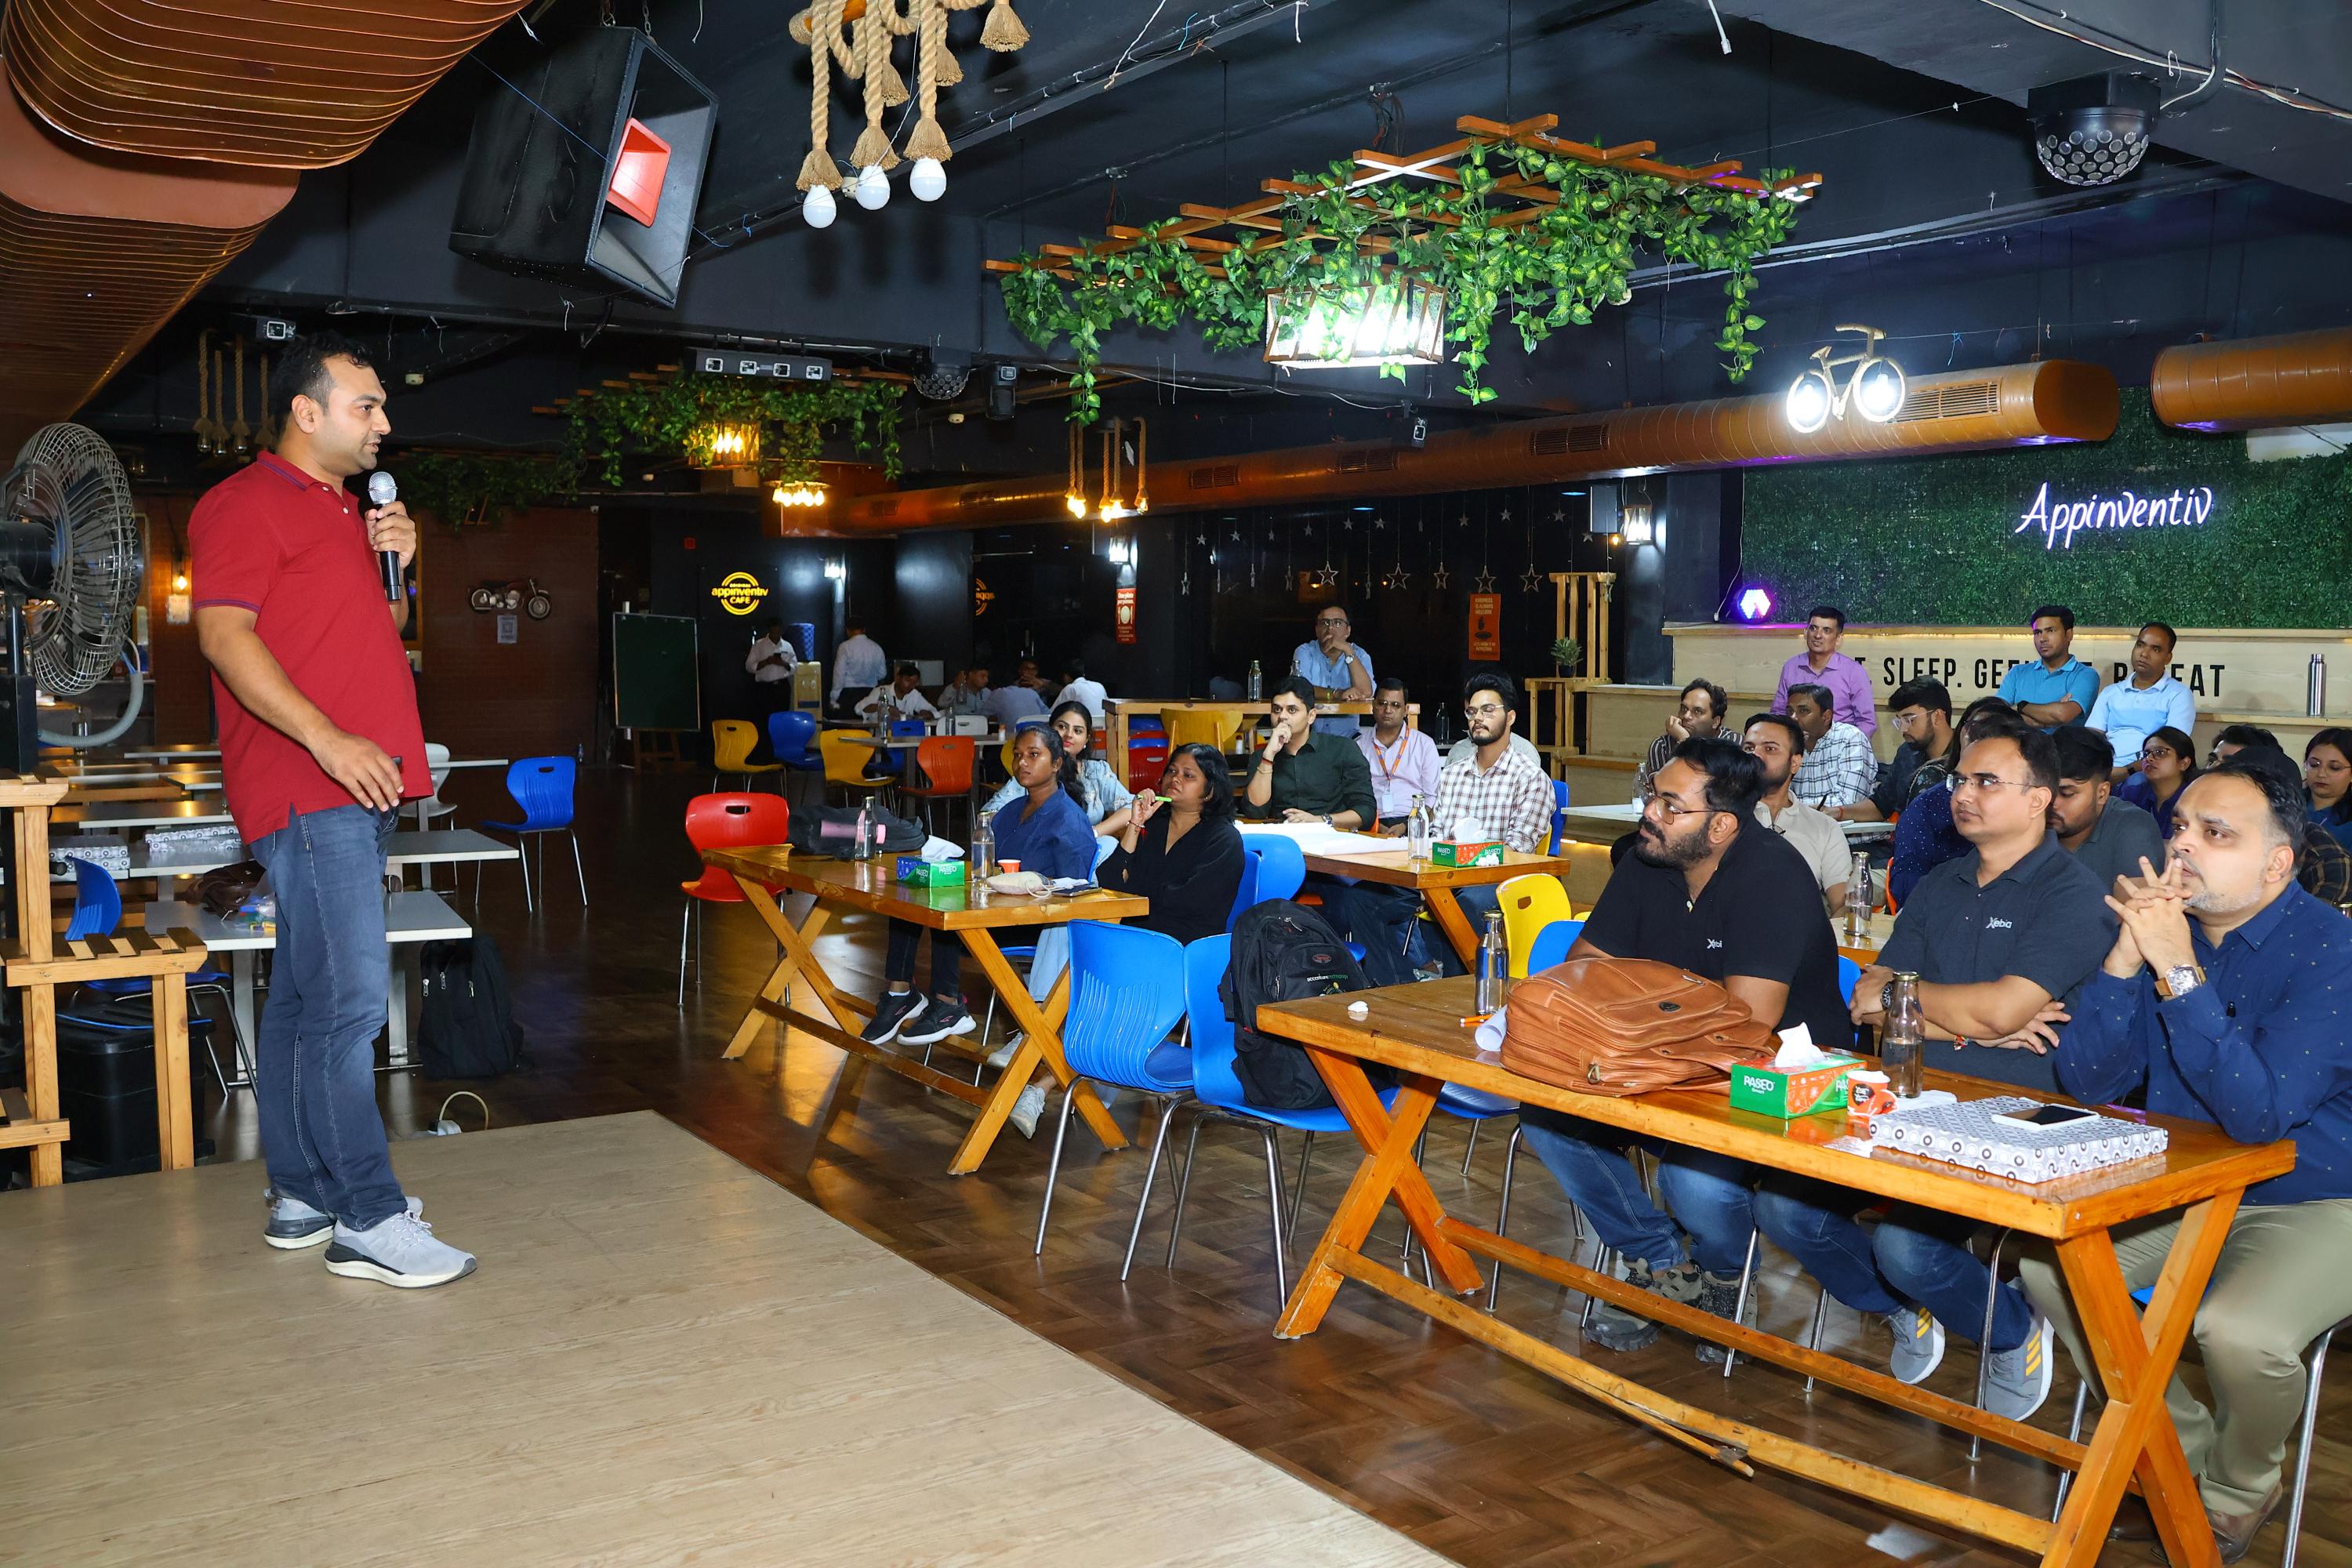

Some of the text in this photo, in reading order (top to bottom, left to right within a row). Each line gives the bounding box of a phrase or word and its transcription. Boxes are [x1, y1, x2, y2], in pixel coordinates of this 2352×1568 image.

[2014, 481, 2213, 550] Appinventiv
[711, 586, 769, 598] appinventiv
[1883, 657, 1962, 688] SLEEP.
[2114, 662, 2225, 697] REAT
[1985, 916, 2013, 929] Xebia
[1744, 1075, 1775, 1091] PASEO
